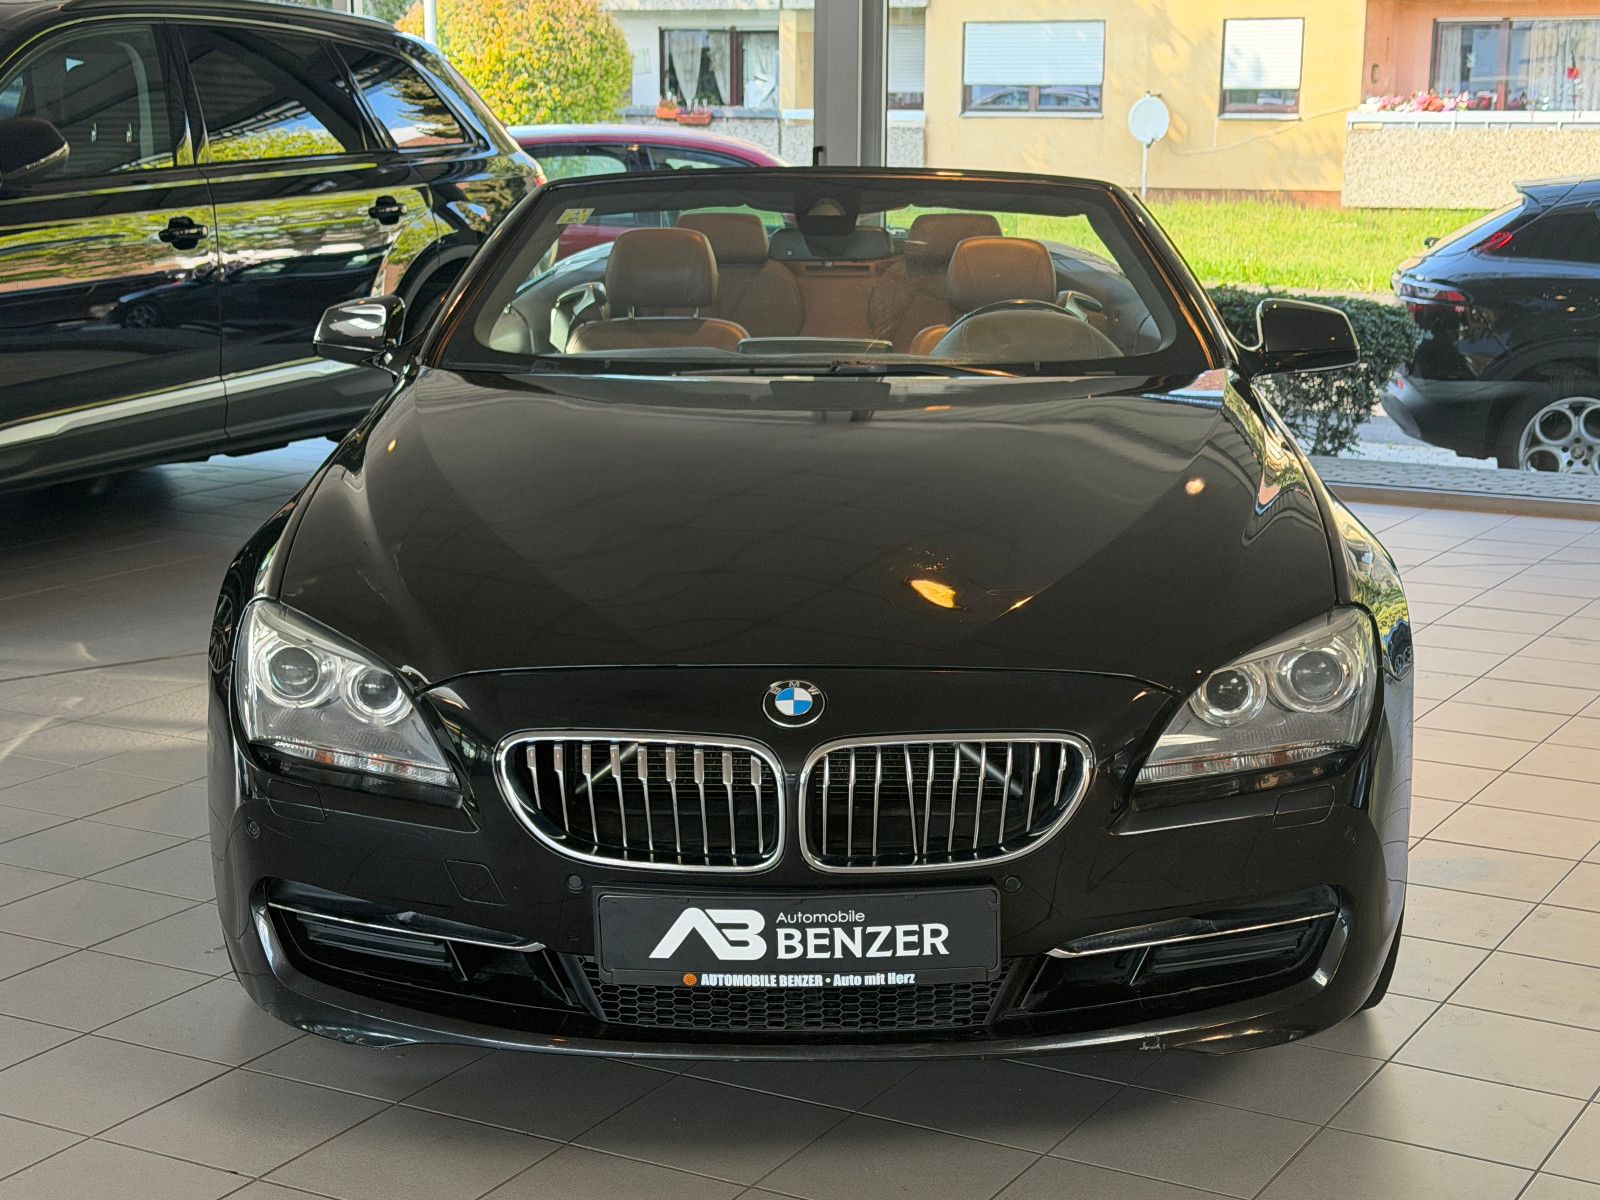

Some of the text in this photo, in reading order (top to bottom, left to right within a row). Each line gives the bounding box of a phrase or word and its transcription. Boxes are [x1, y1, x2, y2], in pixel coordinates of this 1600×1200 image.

[776, 910, 866, 924] Automobile
[776, 923, 950, 960] BENZER
[700, 972, 916, 987] AUTOMOBILE BENZER Auto mit Herz
